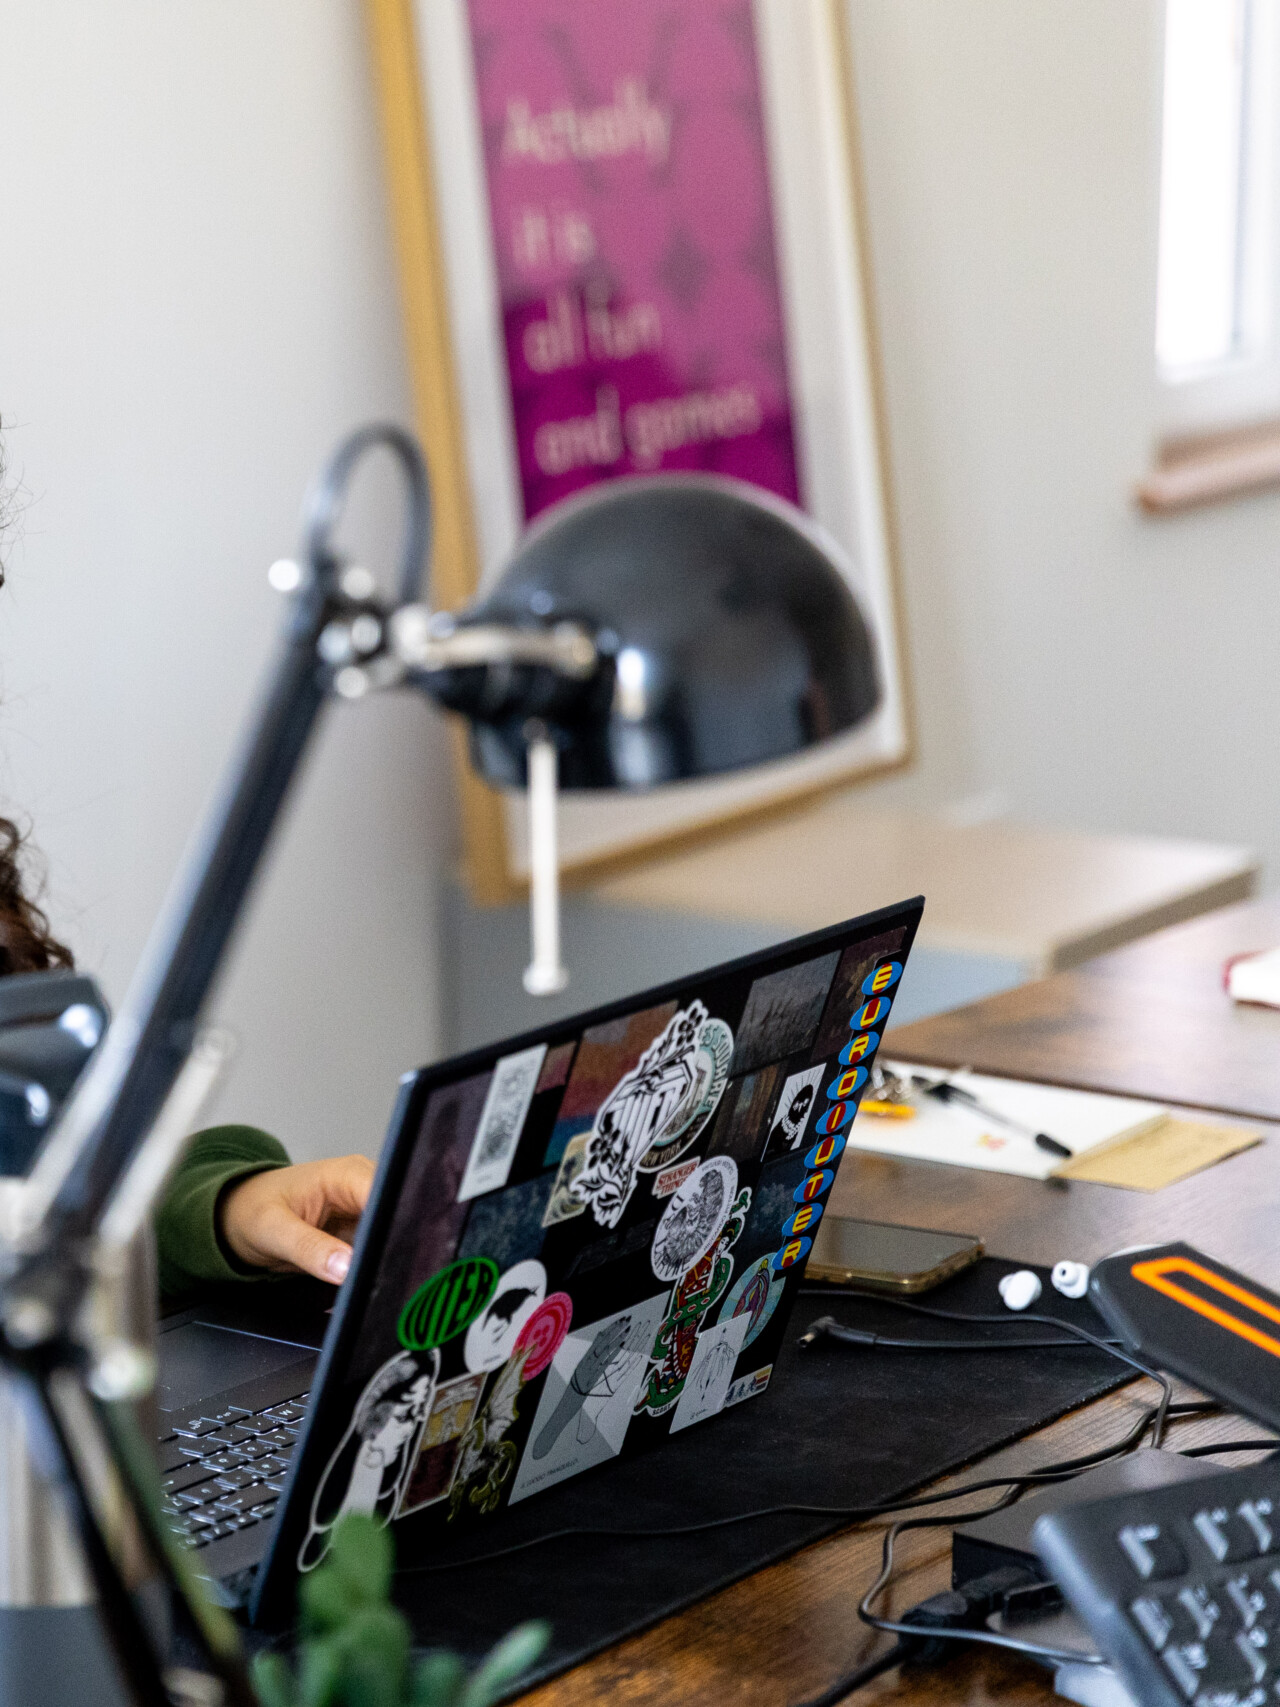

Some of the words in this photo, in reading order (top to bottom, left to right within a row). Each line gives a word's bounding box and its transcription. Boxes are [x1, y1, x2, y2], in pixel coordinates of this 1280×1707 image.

[504, 84, 670, 164] Actually
[556, 207, 594, 264] is
[524, 297, 581, 372] all
[587, 296, 660, 359] fun
[535, 386, 619, 474] and
[626, 386, 761, 470] games
